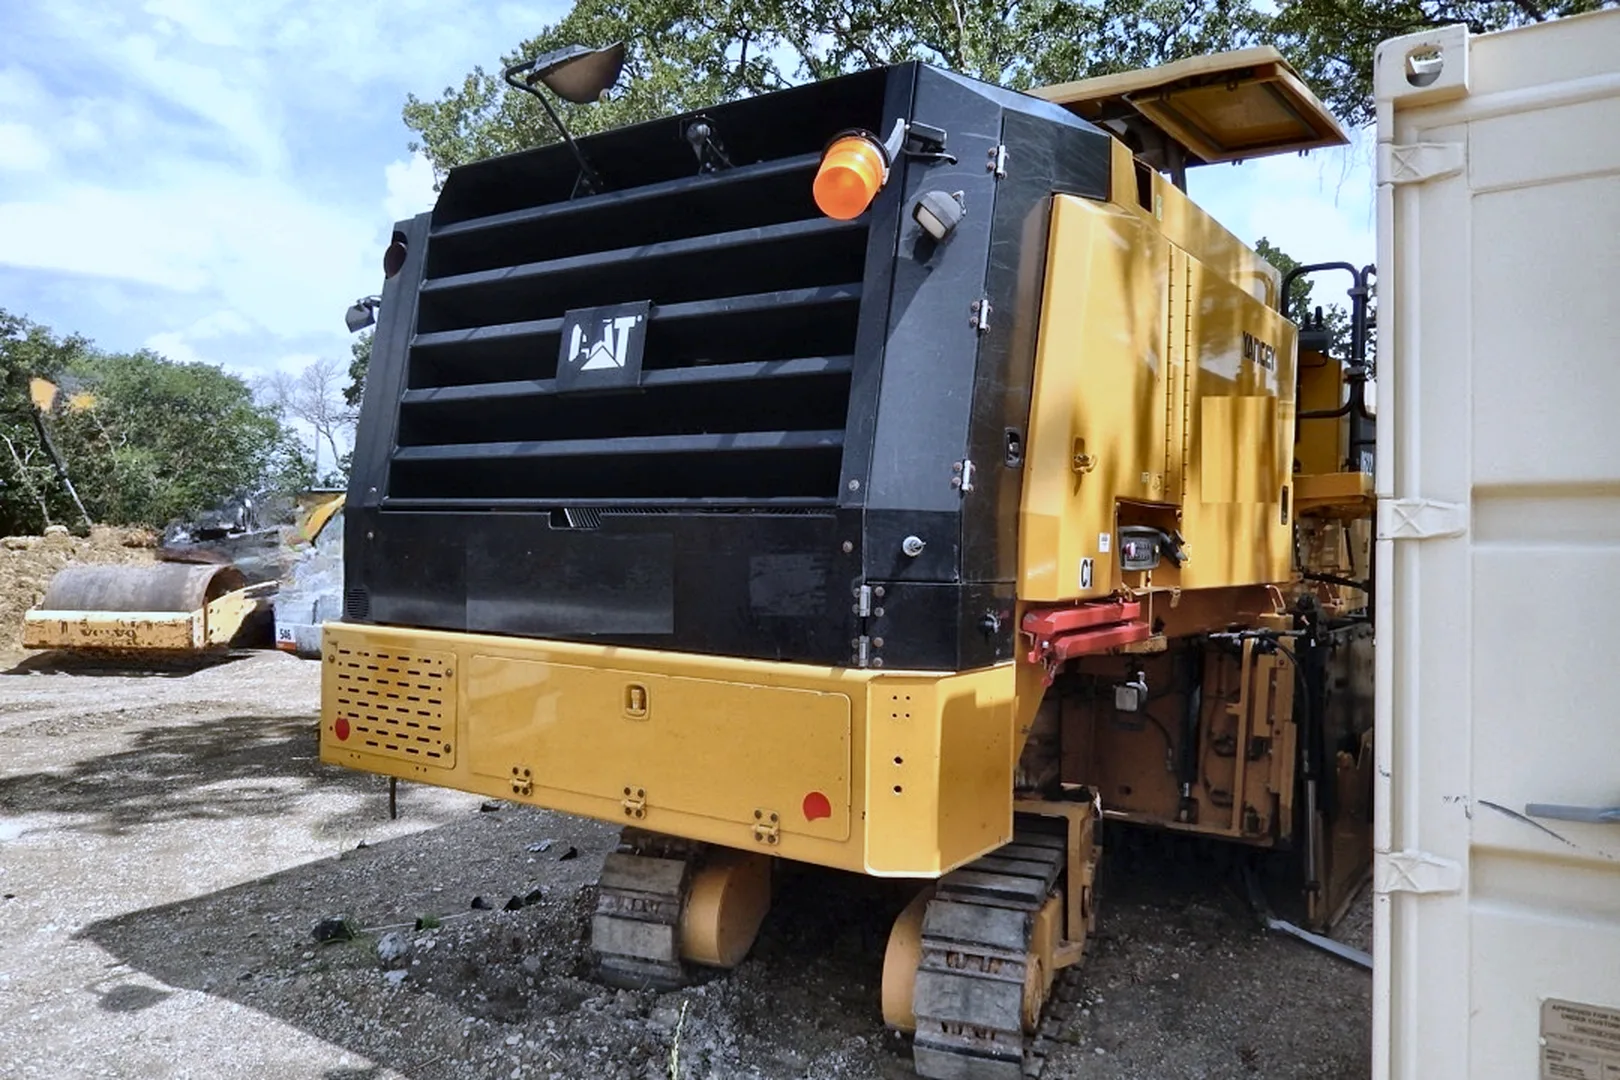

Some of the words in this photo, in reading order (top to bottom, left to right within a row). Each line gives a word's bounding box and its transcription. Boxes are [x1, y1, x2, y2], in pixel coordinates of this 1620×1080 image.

[568, 316, 637, 368] CAT
[1242, 331, 1276, 371] YANCEY
[1080, 559, 1094, 587] C1
